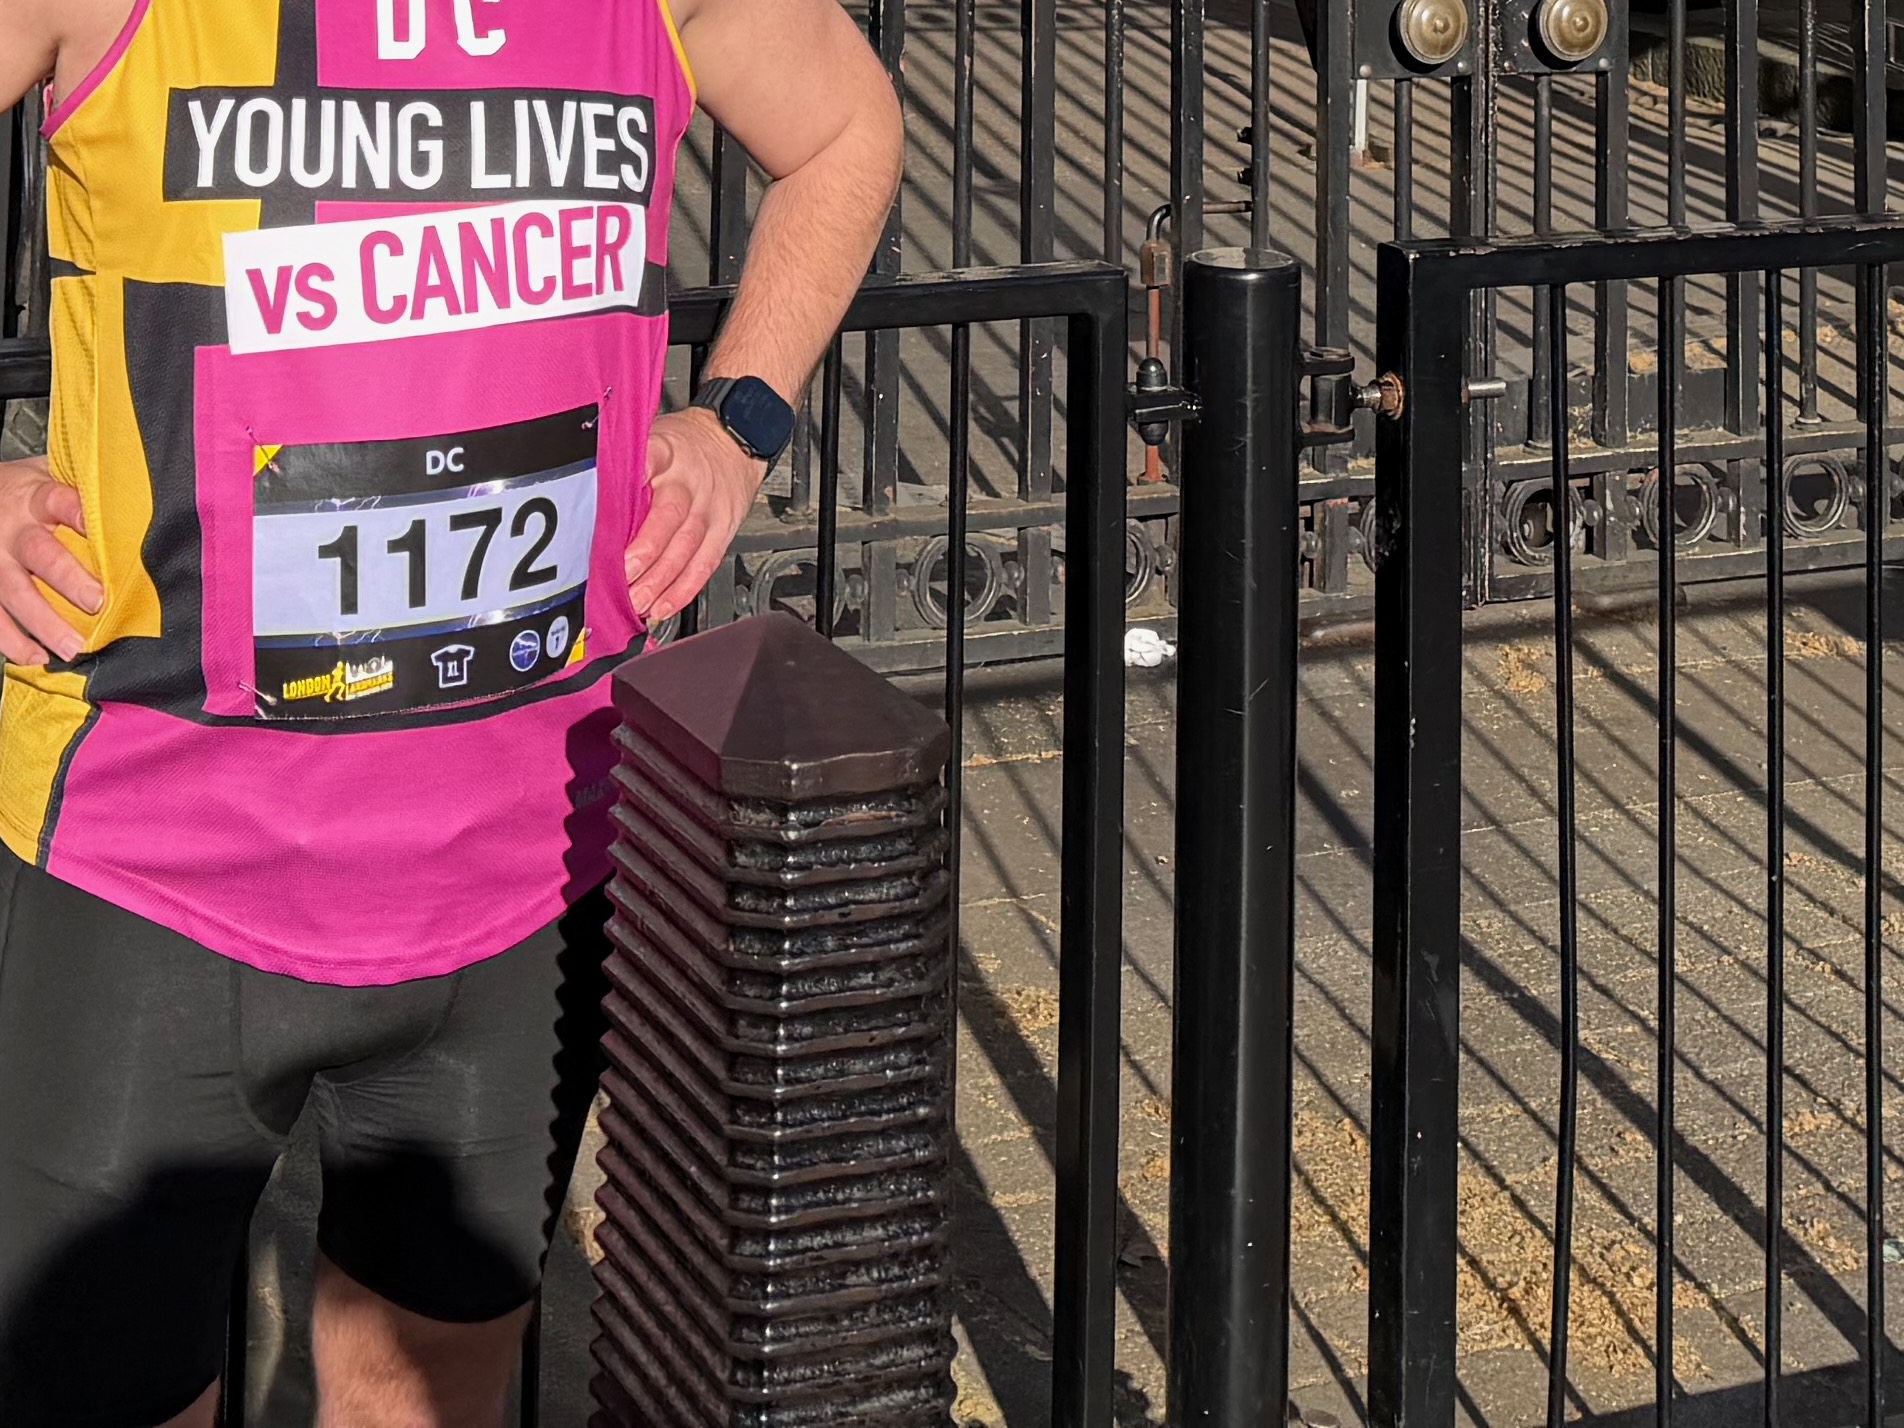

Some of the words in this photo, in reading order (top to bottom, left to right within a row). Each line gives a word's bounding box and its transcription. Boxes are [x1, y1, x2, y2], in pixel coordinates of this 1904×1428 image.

[187, 97, 444, 191] YOUNG
[470, 99, 650, 193] LIVES
[358, 204, 633, 326] CANCER
[425, 446, 465, 475] DC
[317, 496, 559, 616] 1172
[282, 674, 331, 700] LONDON
[446, 660, 460, 678] XL
